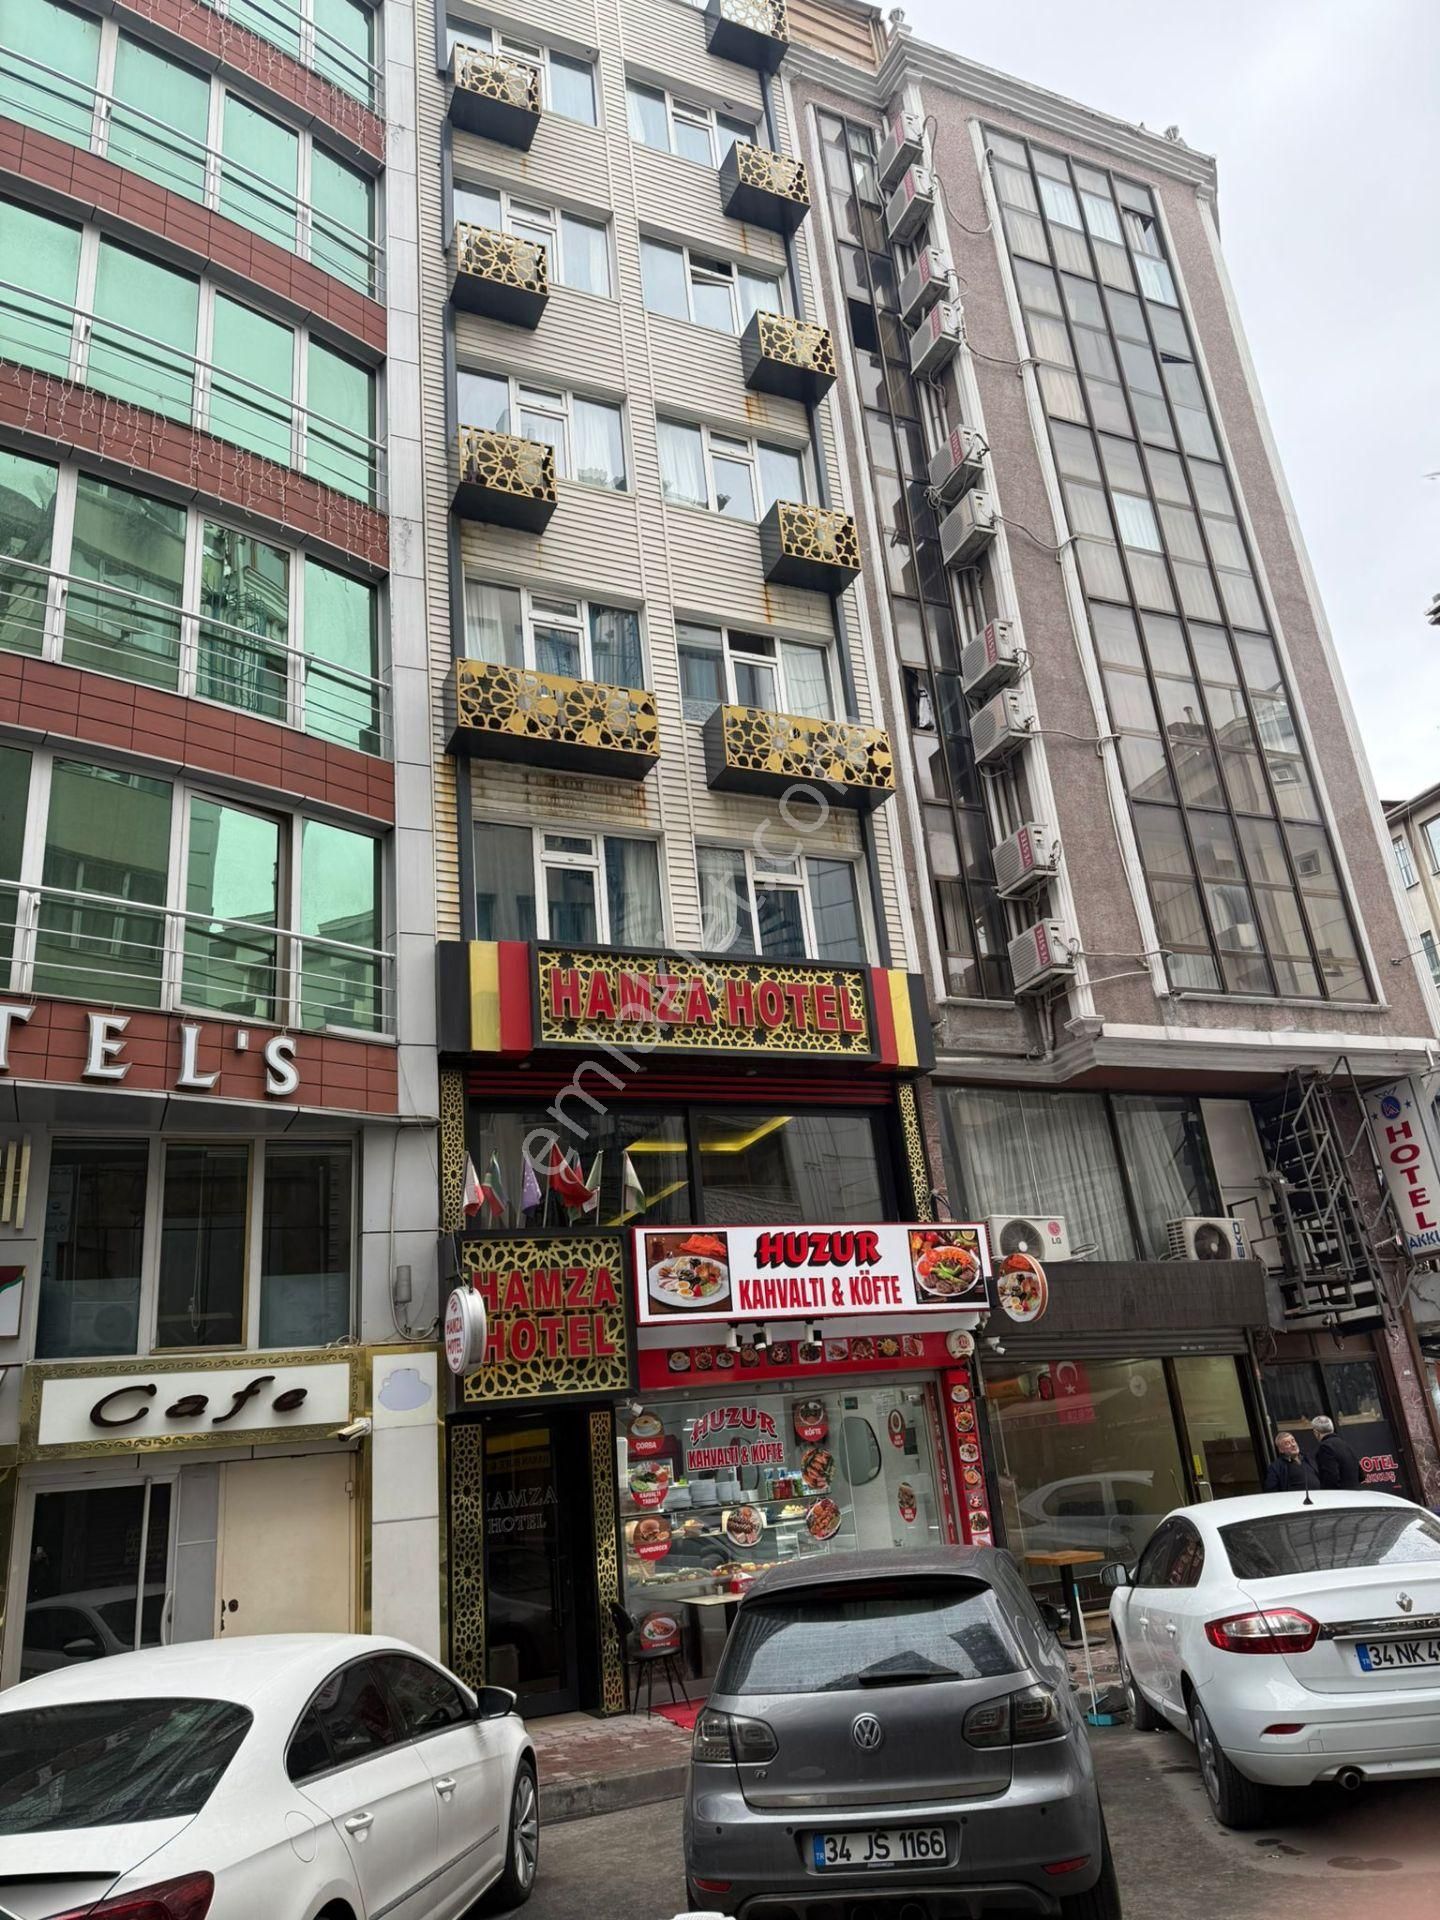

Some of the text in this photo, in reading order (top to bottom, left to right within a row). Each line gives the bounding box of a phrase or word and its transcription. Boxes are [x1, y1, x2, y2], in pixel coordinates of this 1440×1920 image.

[985, 625, 997, 662] VESTEL
[1018, 829, 1032, 867] VESTEL
[1035, 926, 1049, 965] VESTEL
[551, 968, 865, 1034] HAMZA HOTEL
[1385, 1121, 1437, 1230] HOTEL
[755, 1231, 882, 1269] HUZUR
[1233, 1222, 1246, 1260] EKO
[473, 1268, 617, 1311] HAMZA
[739, 1269, 903, 1310] KAHVALTI & KÖFTE
[447, 1337, 463, 1355] HOTEL
[483, 1313, 616, 1364] HOTEL
[90, 1375, 308, 1428] Cafe
[690, 1406, 778, 1447] HUZUR
[687, 1440, 785, 1472] KAHVALTI & KÖFTE
[487, 1513, 548, 1534] HOTEL
[1369, 1645, 1394, 1666] 34
[1395, 1642, 1426, 1664] NK
[815, 1852, 824, 1861] TR
[825, 1830, 944, 1863] 34 JS 1166
